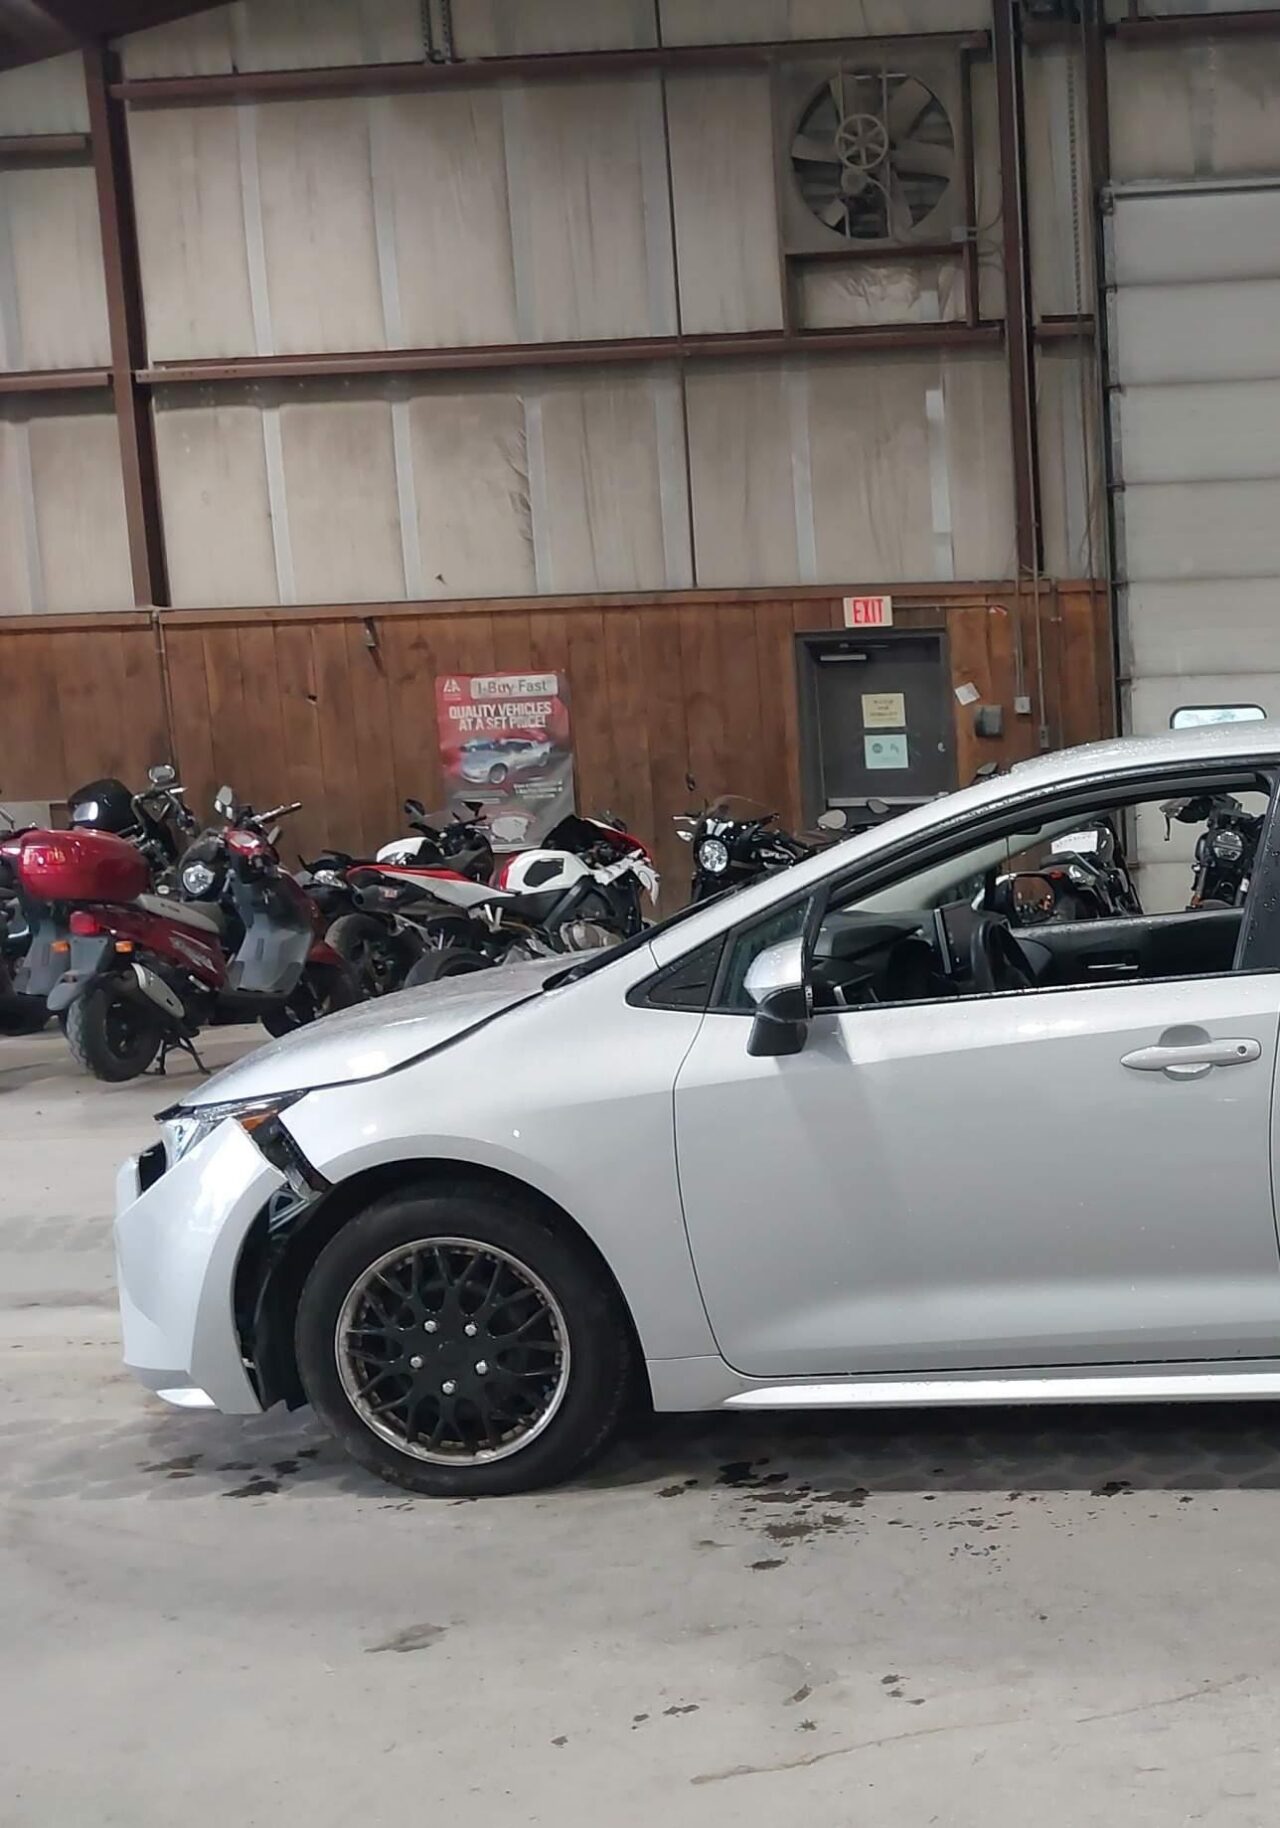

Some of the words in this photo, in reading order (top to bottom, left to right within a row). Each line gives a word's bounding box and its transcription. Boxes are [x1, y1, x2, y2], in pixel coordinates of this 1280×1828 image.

[852, 598, 884, 624] EXIT
[518, 679, 548, 692] Fast
[449, 704, 497, 719] QUALITY
[497, 701, 552, 716] VEHICLES
[459, 719, 476, 732] AT
[476, 718, 485, 731] A
[486, 717, 507, 730] SET
